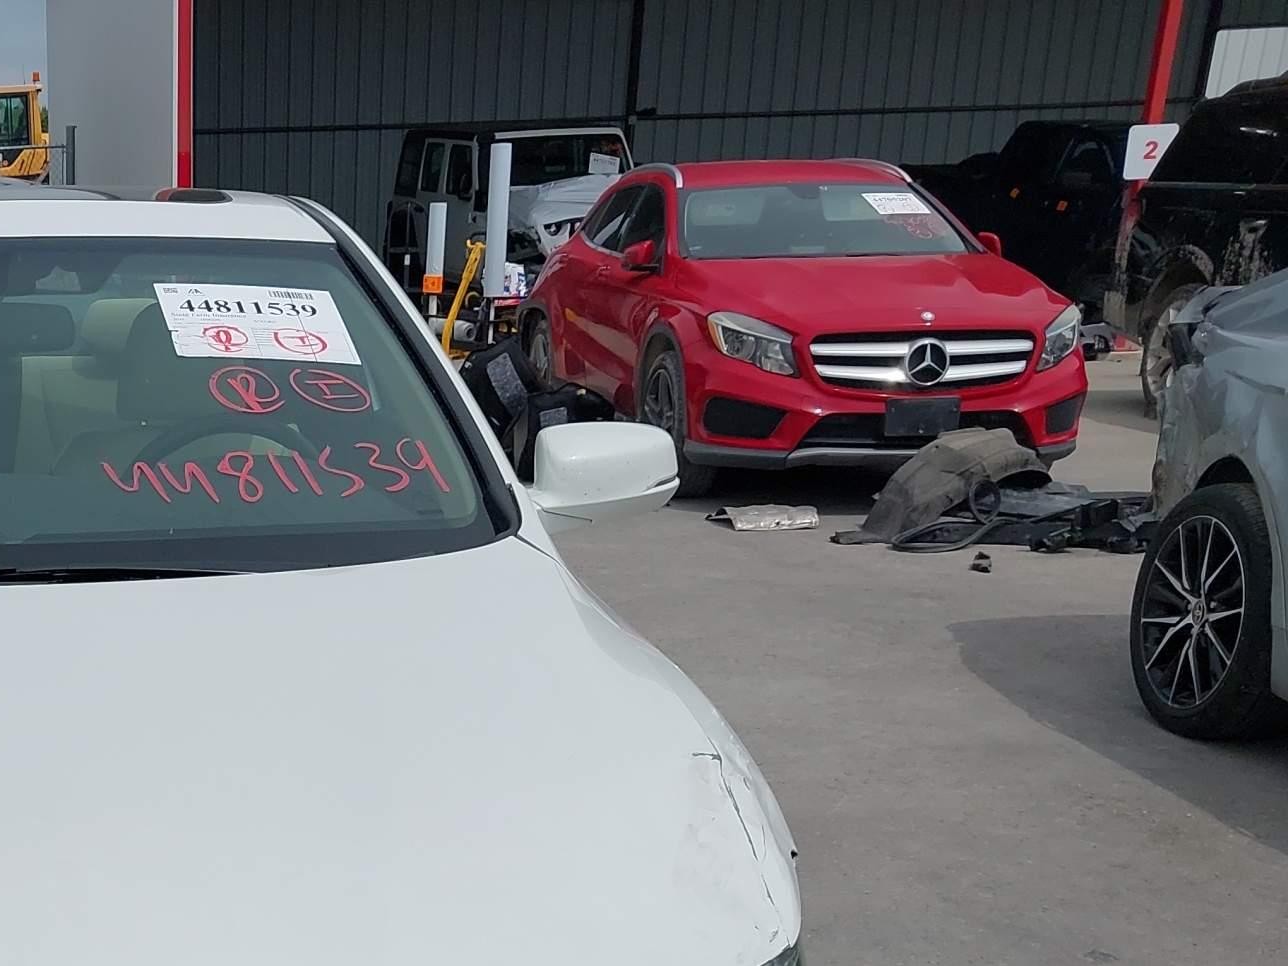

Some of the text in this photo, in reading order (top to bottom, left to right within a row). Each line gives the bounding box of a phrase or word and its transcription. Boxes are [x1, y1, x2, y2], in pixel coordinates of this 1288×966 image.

[1143, 140, 1159, 160] 2
[179, 298, 318, 318] 44811539
[100, 438, 451, 503] 44811539
